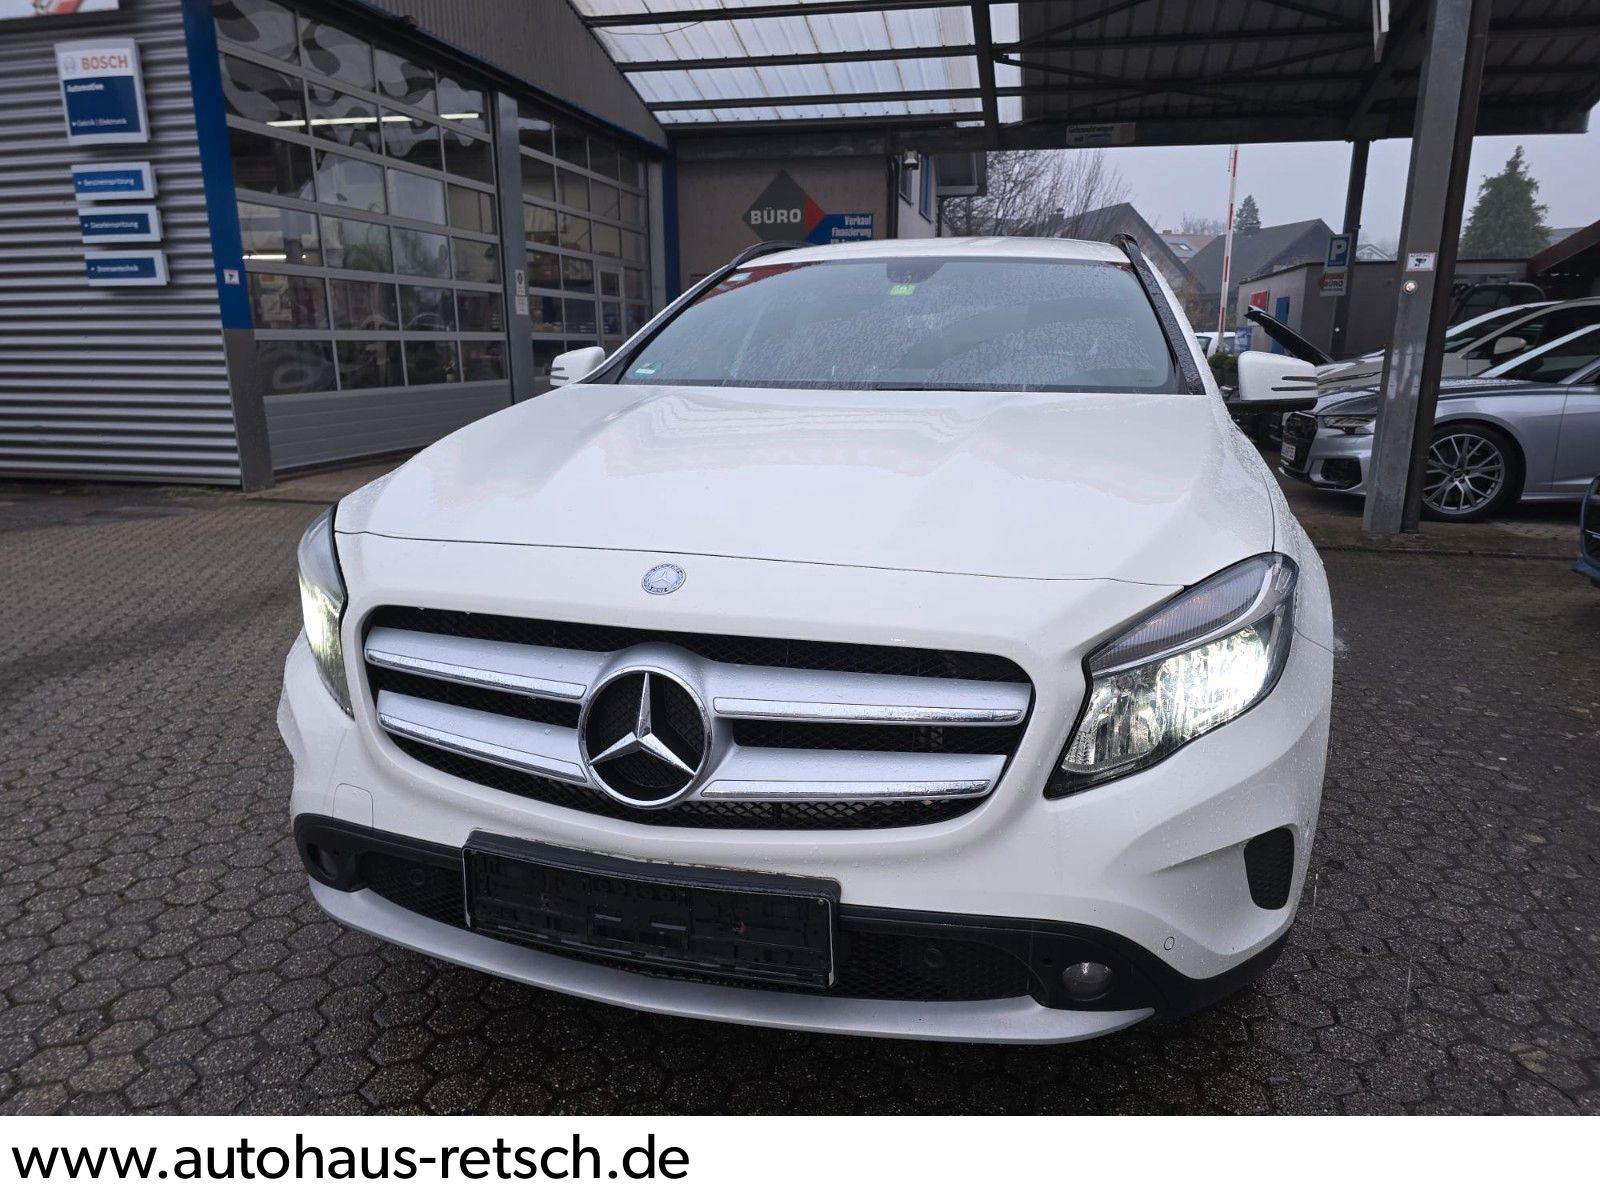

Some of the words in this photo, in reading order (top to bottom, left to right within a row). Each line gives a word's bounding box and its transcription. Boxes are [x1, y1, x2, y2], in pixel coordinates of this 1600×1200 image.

[81, 55, 129, 70] BOSCH
[750, 207, 802, 225] BÜRO
[844, 215, 872, 225] Verkauf
[832, 227, 872, 238] Finanzierung
[1330, 239, 1347, 260] P
